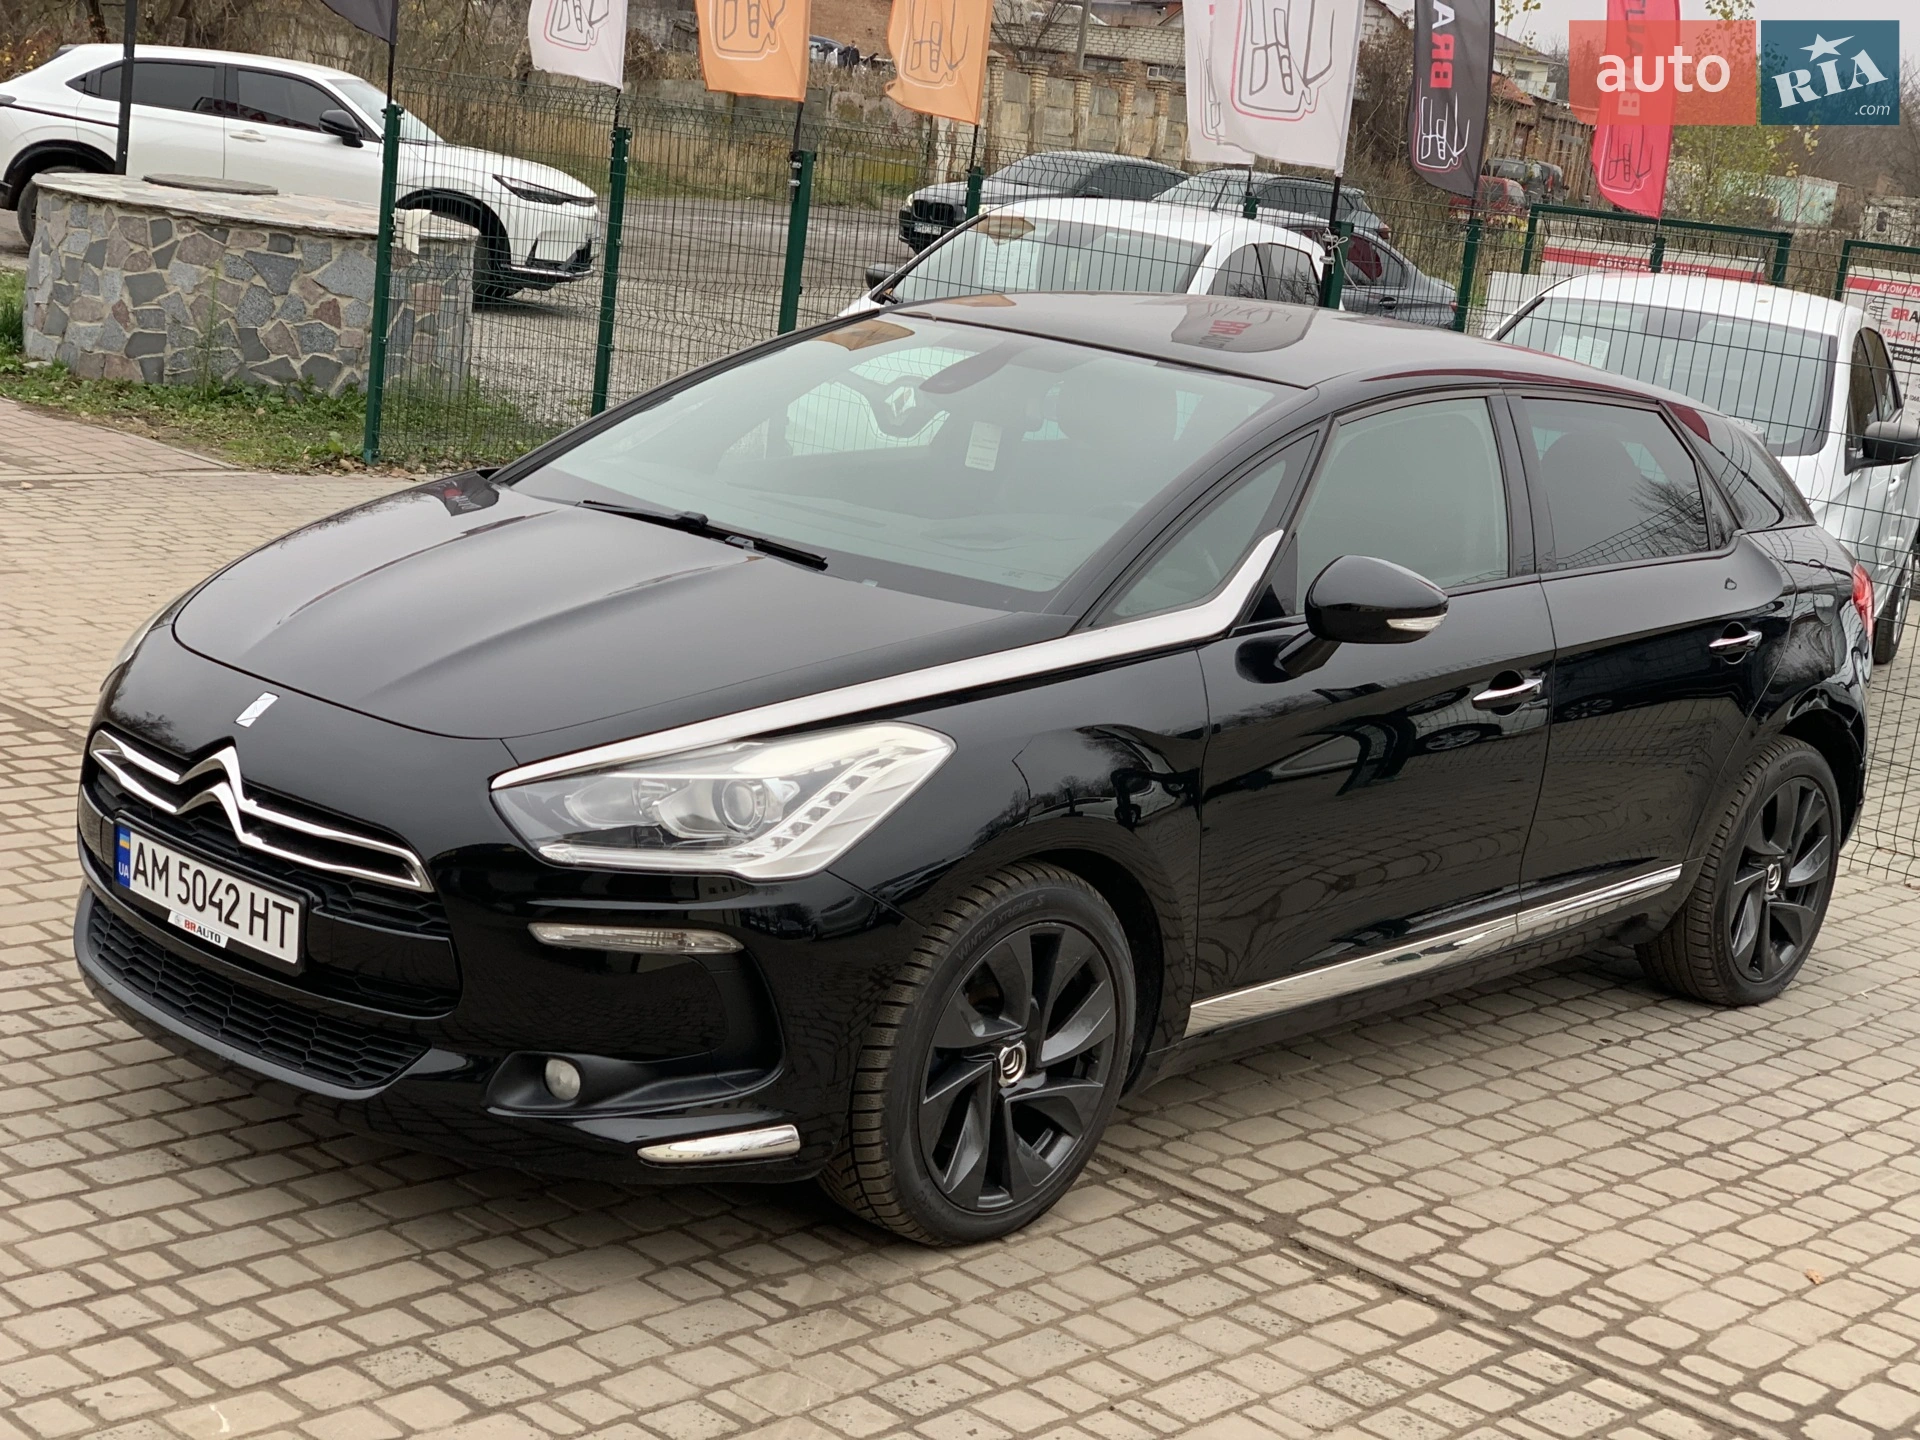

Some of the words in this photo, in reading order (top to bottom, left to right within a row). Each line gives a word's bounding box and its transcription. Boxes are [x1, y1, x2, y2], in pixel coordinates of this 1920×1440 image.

[118, 862, 129, 879] UA
[132, 841, 170, 898] AM
[177, 860, 241, 930] 5042
[248, 891, 294, 949] HT
[183, 918, 222, 945] BRAUTO
